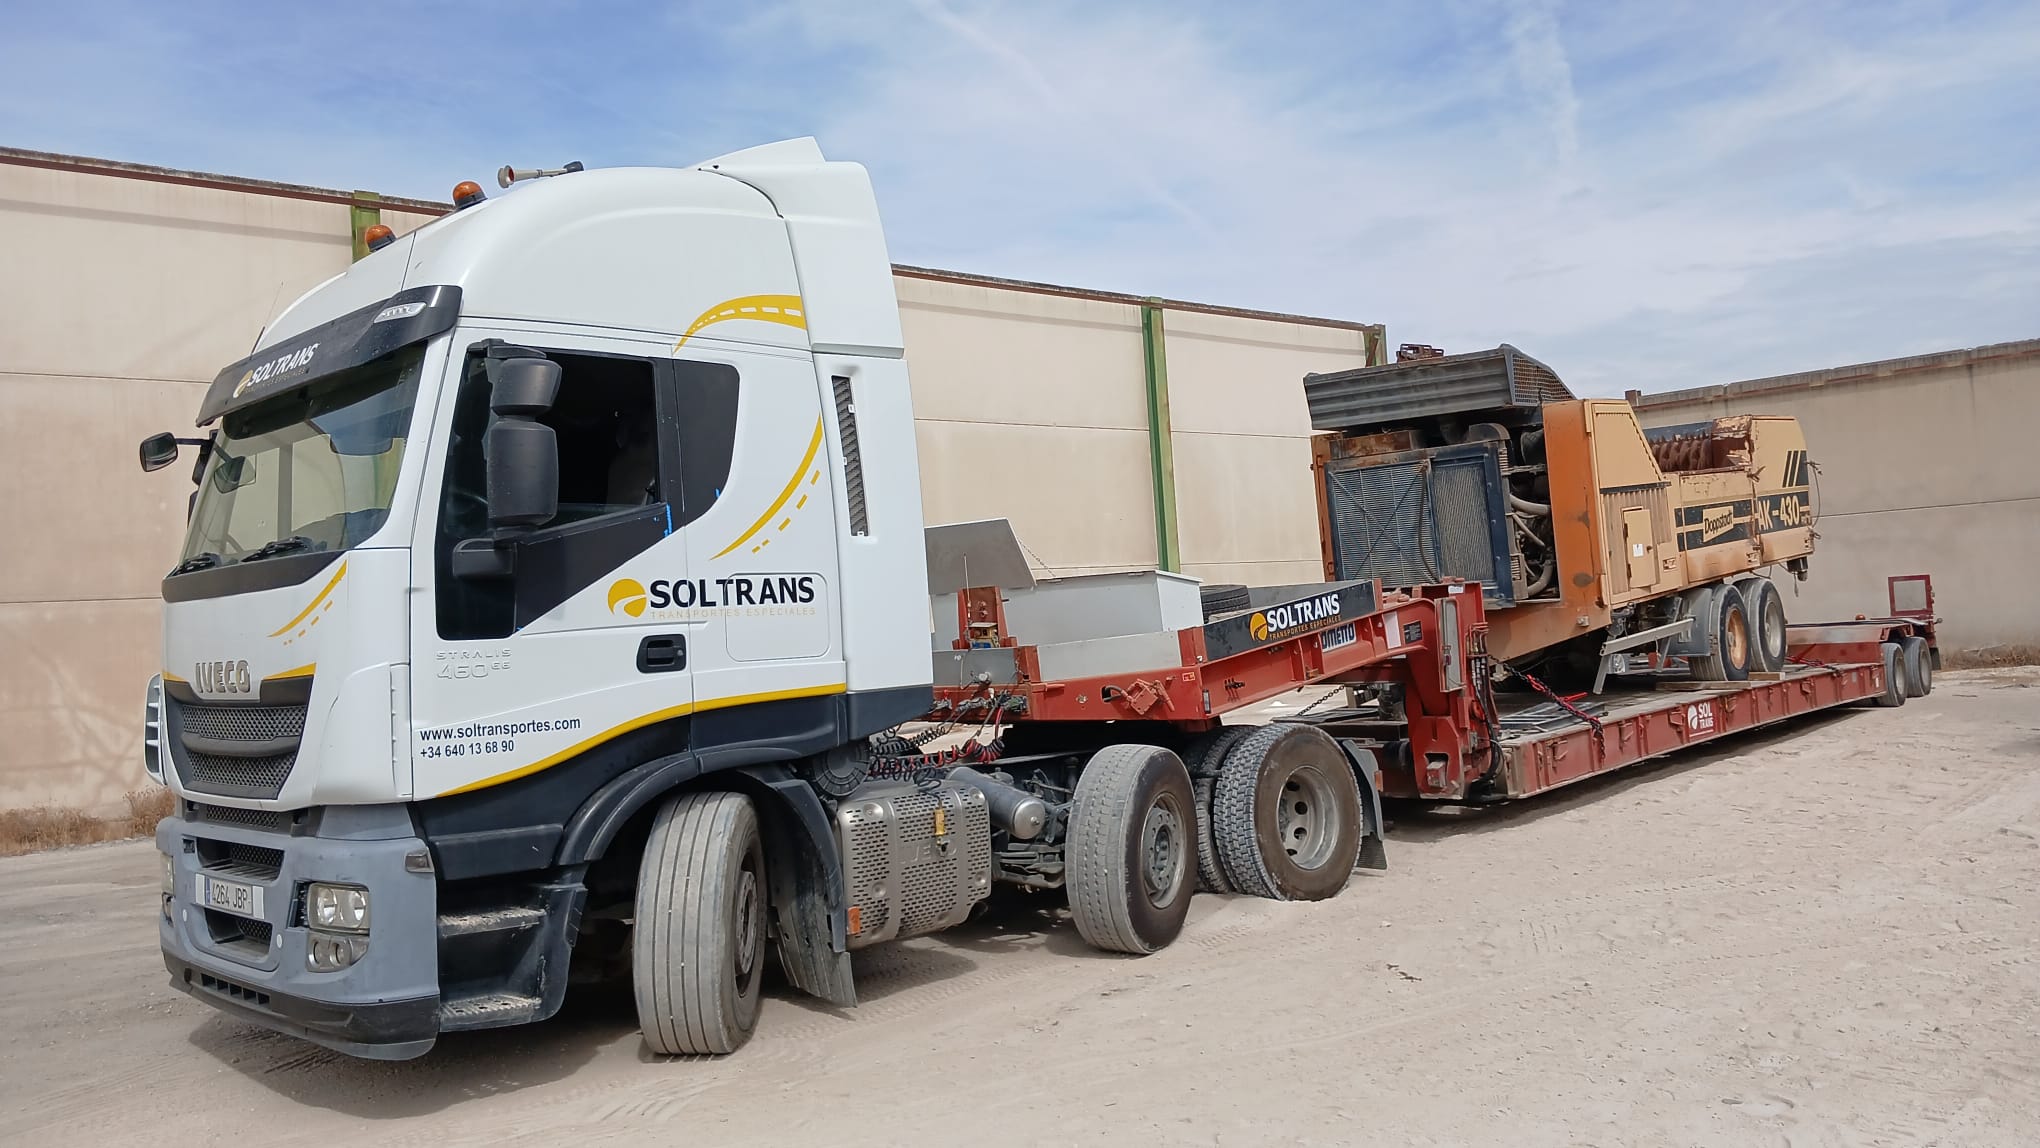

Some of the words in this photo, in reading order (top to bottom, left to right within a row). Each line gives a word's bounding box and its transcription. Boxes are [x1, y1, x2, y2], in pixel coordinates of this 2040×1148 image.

[247, 342, 321, 388] SOLTRANS
[1758, 494, 1800, 531] AK-430
[650, 576, 815, 609] SOLTRANS
[650, 607, 740, 619] TRANSPORTES
[746, 606, 817, 617] ESPECIALES
[1266, 593, 1340, 633] SOLTRANS
[1269, 624, 1309, 641] TRANSPORTES
[1310, 614, 1342, 629] ESPECIALES
[436, 648, 512, 661] STRALIS
[195, 659, 251, 694] IVECO
[437, 663, 489, 680] 460
[1698, 701, 1713, 718] SOL
[420, 718, 581, 741] www.soltransportes.com
[420, 745, 441, 759] +34
[445, 743, 465, 757] 640
[469, 742, 482, 755] 13
[485, 741, 498, 754] 68
[502, 739, 514, 752] 90
[212, 882, 230, 907] 4264
[233, 887, 248, 910] JBP
